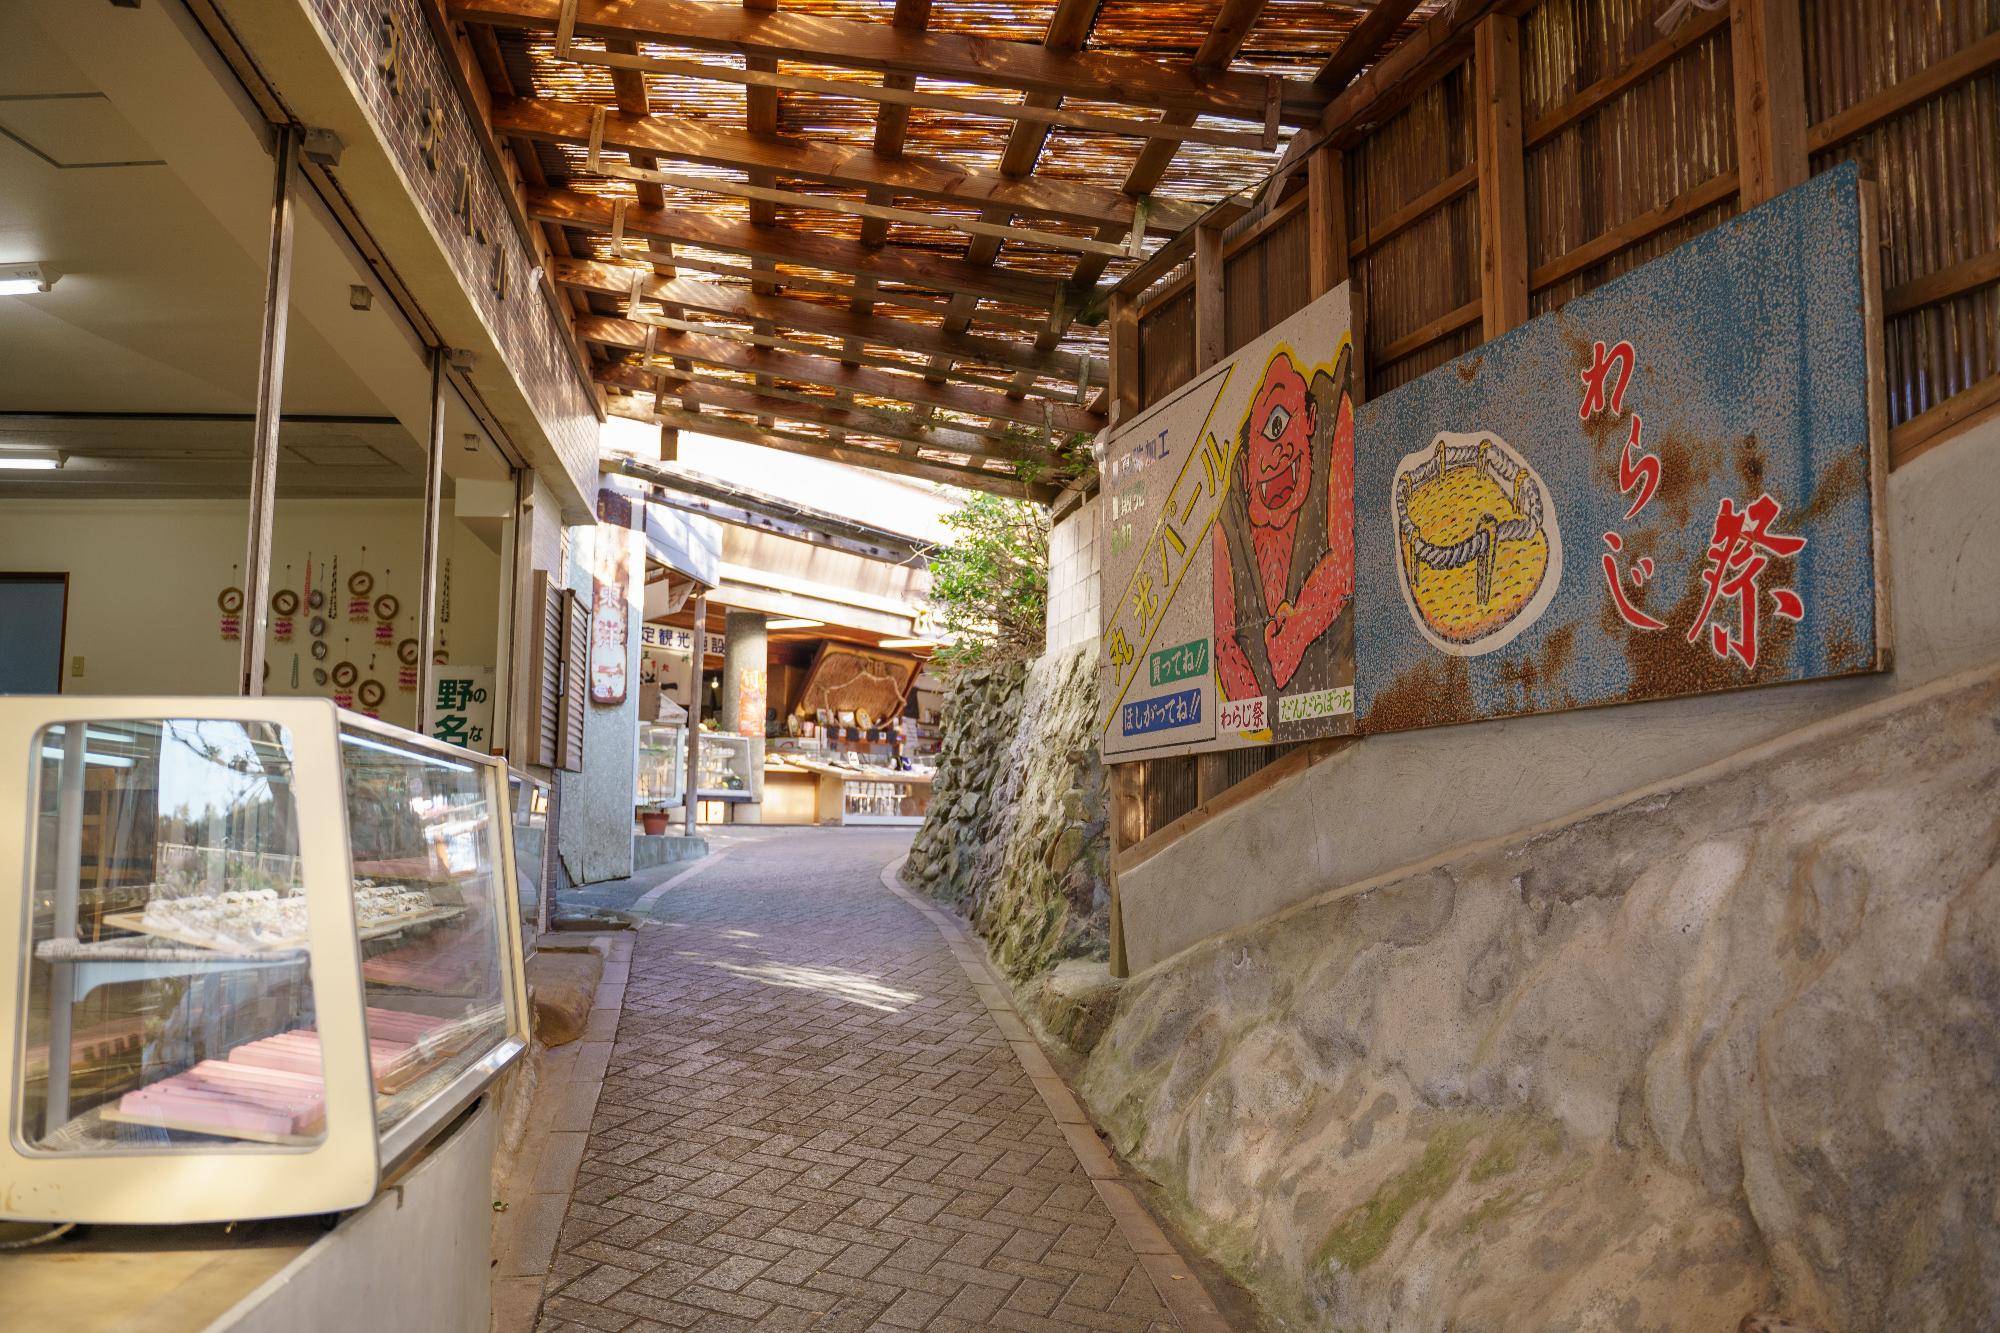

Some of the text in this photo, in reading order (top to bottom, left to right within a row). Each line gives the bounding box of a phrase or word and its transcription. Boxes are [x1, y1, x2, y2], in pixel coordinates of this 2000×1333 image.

[1579, 340, 1808, 670] わらじ祭
[1109, 430, 1230, 687] 丸光パール
[642, 626, 726, 654] 定観光設
[1220, 701, 1265, 729] わらじ祭
[1281, 688, 1353, 721] だんだらぼっち
